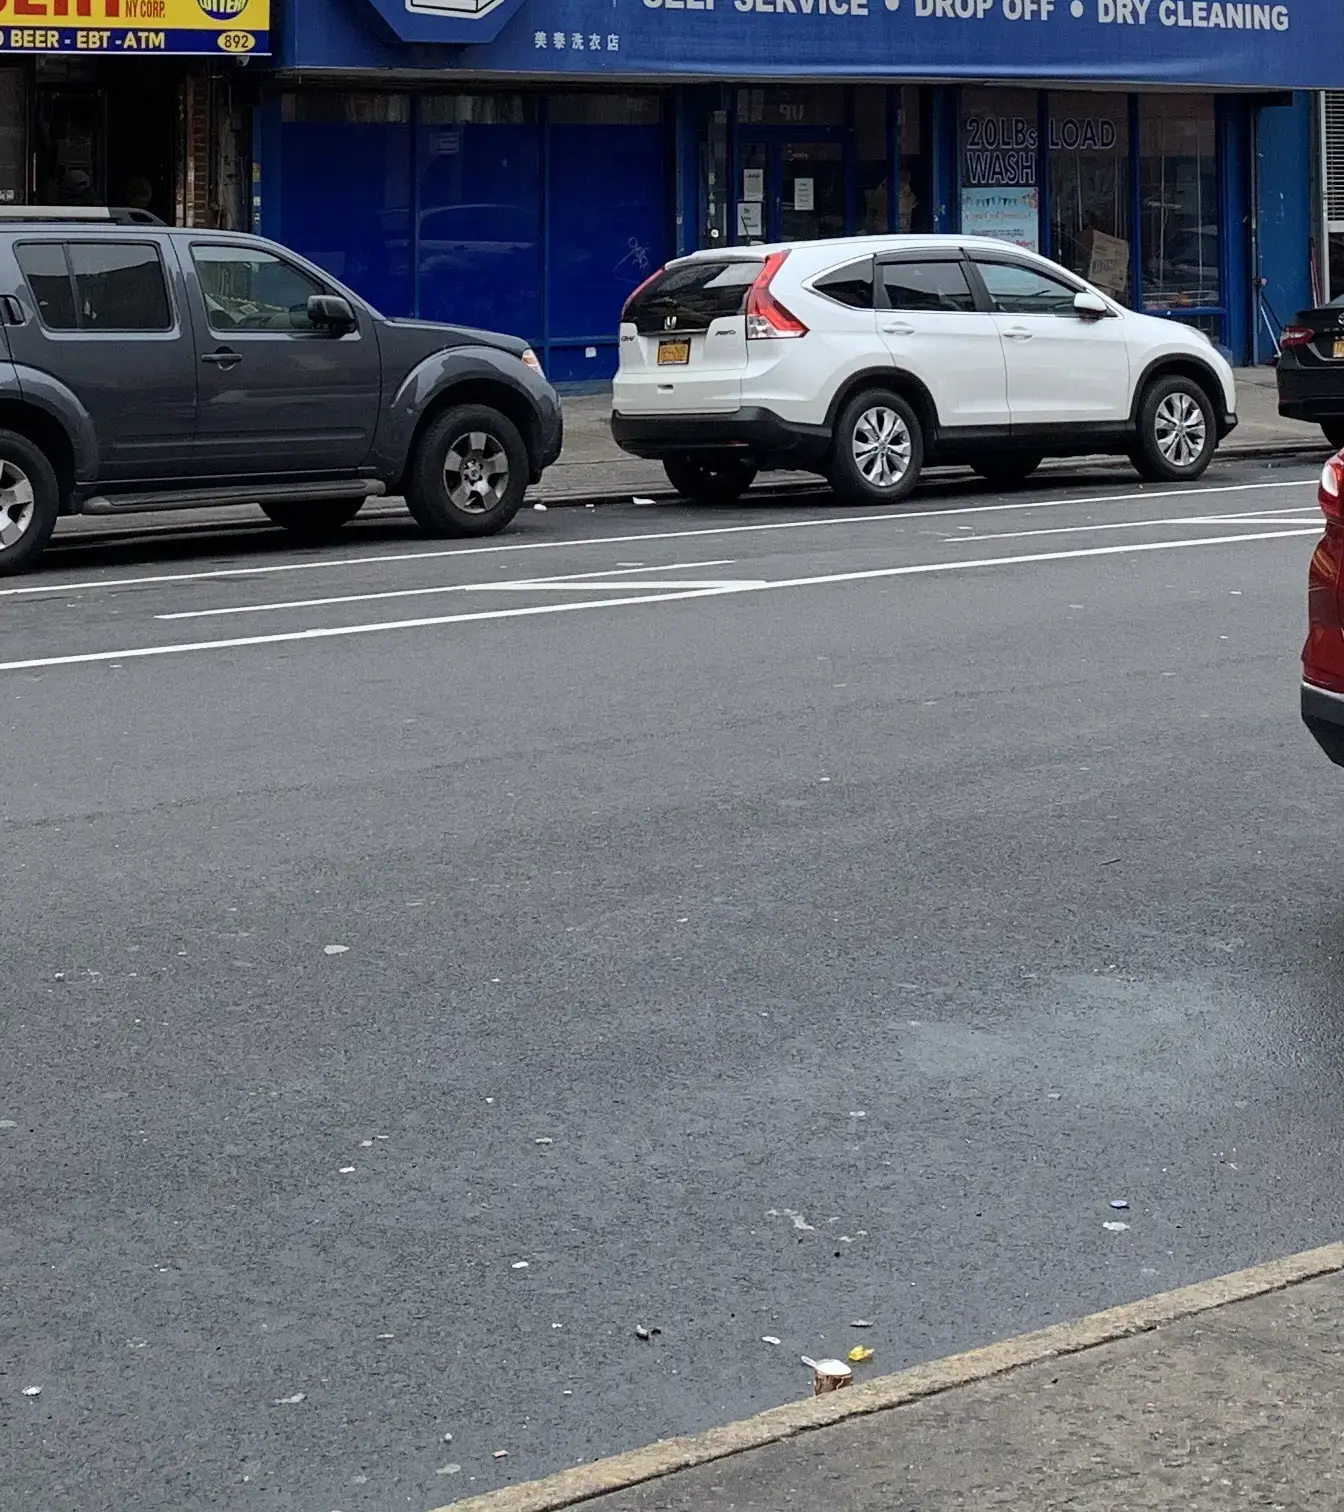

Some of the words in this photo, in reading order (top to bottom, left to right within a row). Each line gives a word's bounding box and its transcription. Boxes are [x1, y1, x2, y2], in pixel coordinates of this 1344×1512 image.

[125, 0, 138, 18] NY
[140, 0, 166, 19] CORP.
[1158, 0, 1290, 32] CLEANING
[10, 30, 59, 49] BEER
[76, 30, 110, 49] EBT
[223, 34, 250, 49] 892
[1048, 117, 1116, 150] LOAD
[966, 151, 1036, 184] WASH
